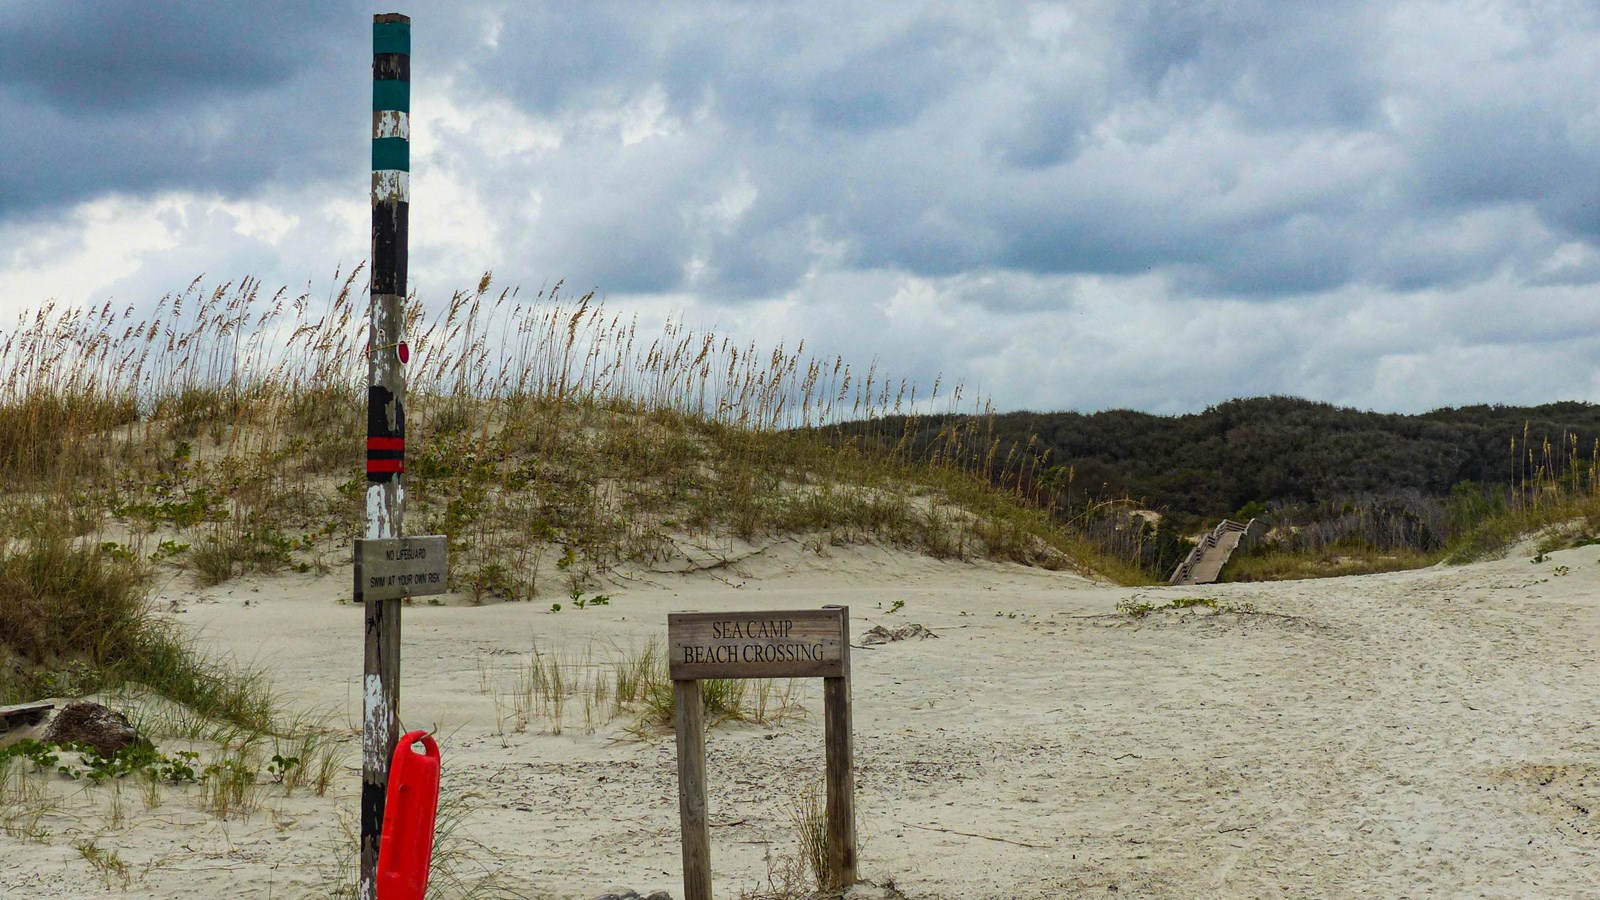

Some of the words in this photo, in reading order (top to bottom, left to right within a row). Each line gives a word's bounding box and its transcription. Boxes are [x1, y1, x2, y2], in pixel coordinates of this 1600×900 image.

[386, 550, 394, 560] NO
[396, 548, 426, 560] LIFEGUARD
[370, 576, 385, 588] SWIM
[388, 575, 395, 586] AT
[398, 574, 412, 586] YOUR
[415, 573, 427, 584] OWN
[428, 572, 440, 583] RISK
[713, 621, 743, 639] SEA
[747, 620, 793, 638] CAMP
[683, 645, 738, 664] BEACH
[743, 644, 824, 663] CROSSING
